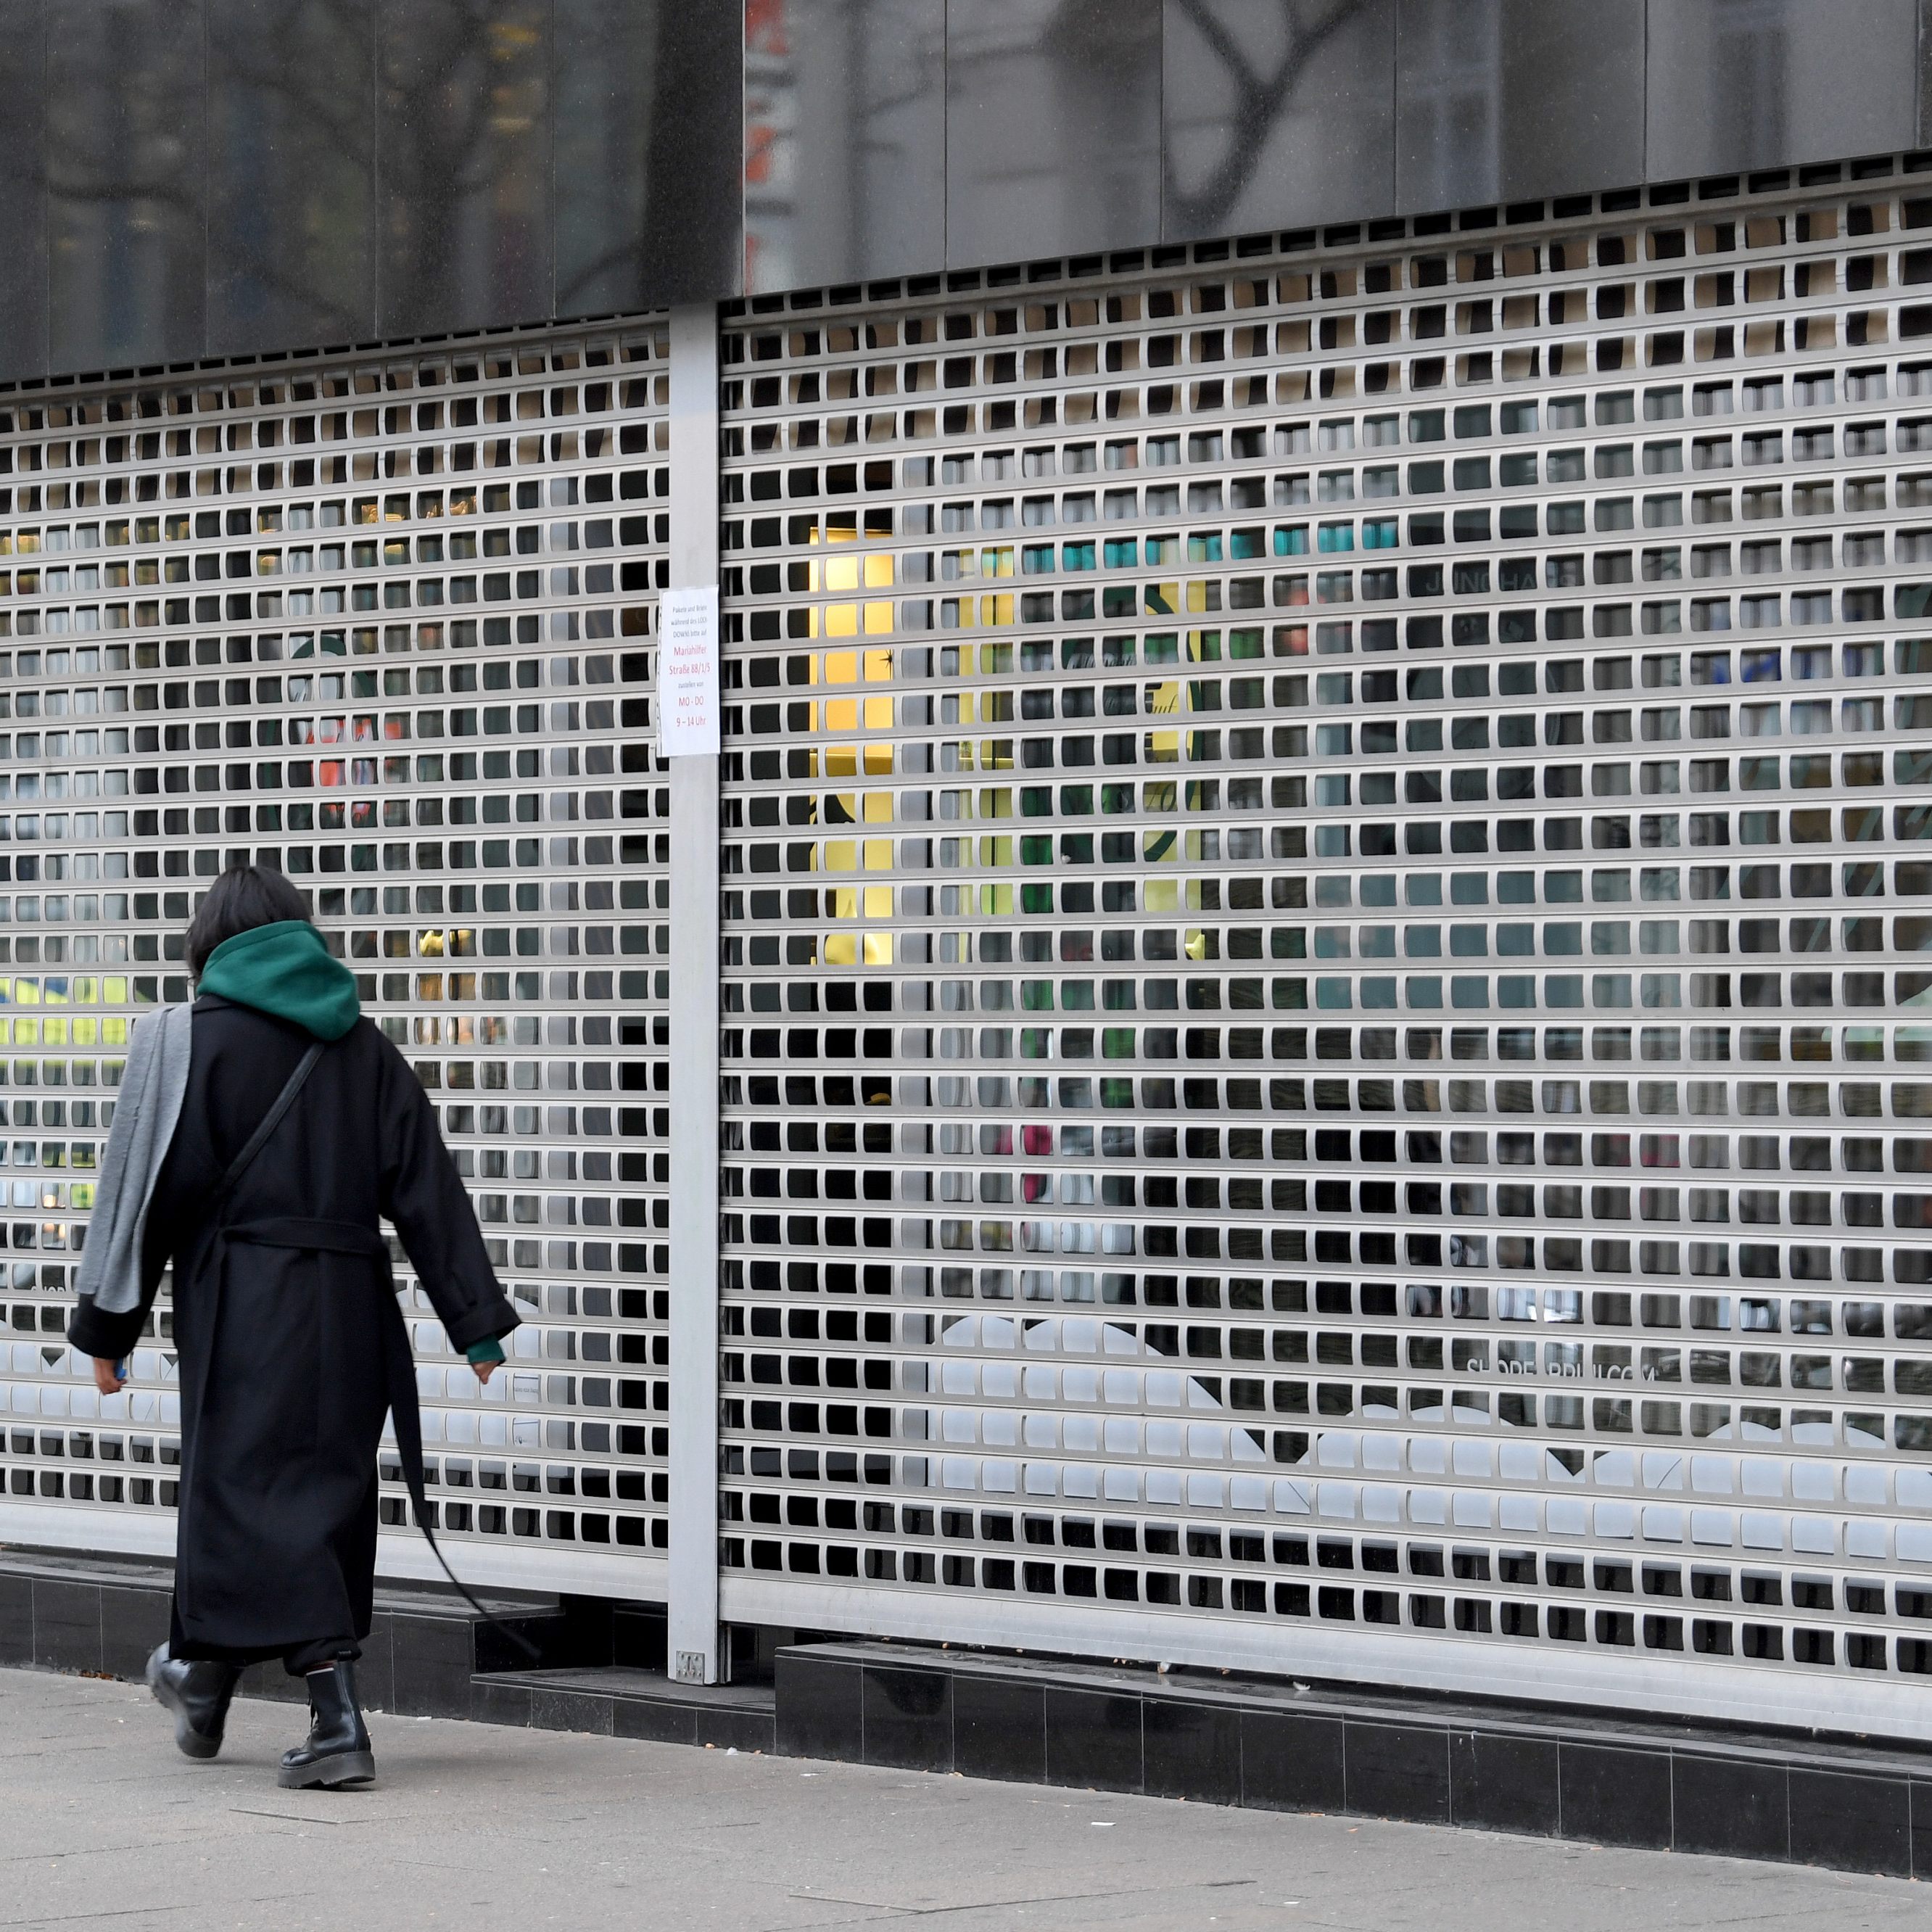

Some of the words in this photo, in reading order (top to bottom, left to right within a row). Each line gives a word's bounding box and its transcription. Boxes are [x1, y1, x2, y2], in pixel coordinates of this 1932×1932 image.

[674, 644, 706, 656] Mariahilfer
[669, 664, 690, 674] Straße
[691, 662, 711, 674] 88/1/5
[679, 697, 690, 706] MO
[695, 696, 704, 706] DO
[677, 717, 681, 727] 9
[688, 717, 694, 726] 14
[695, 716, 706, 725] Uhr
